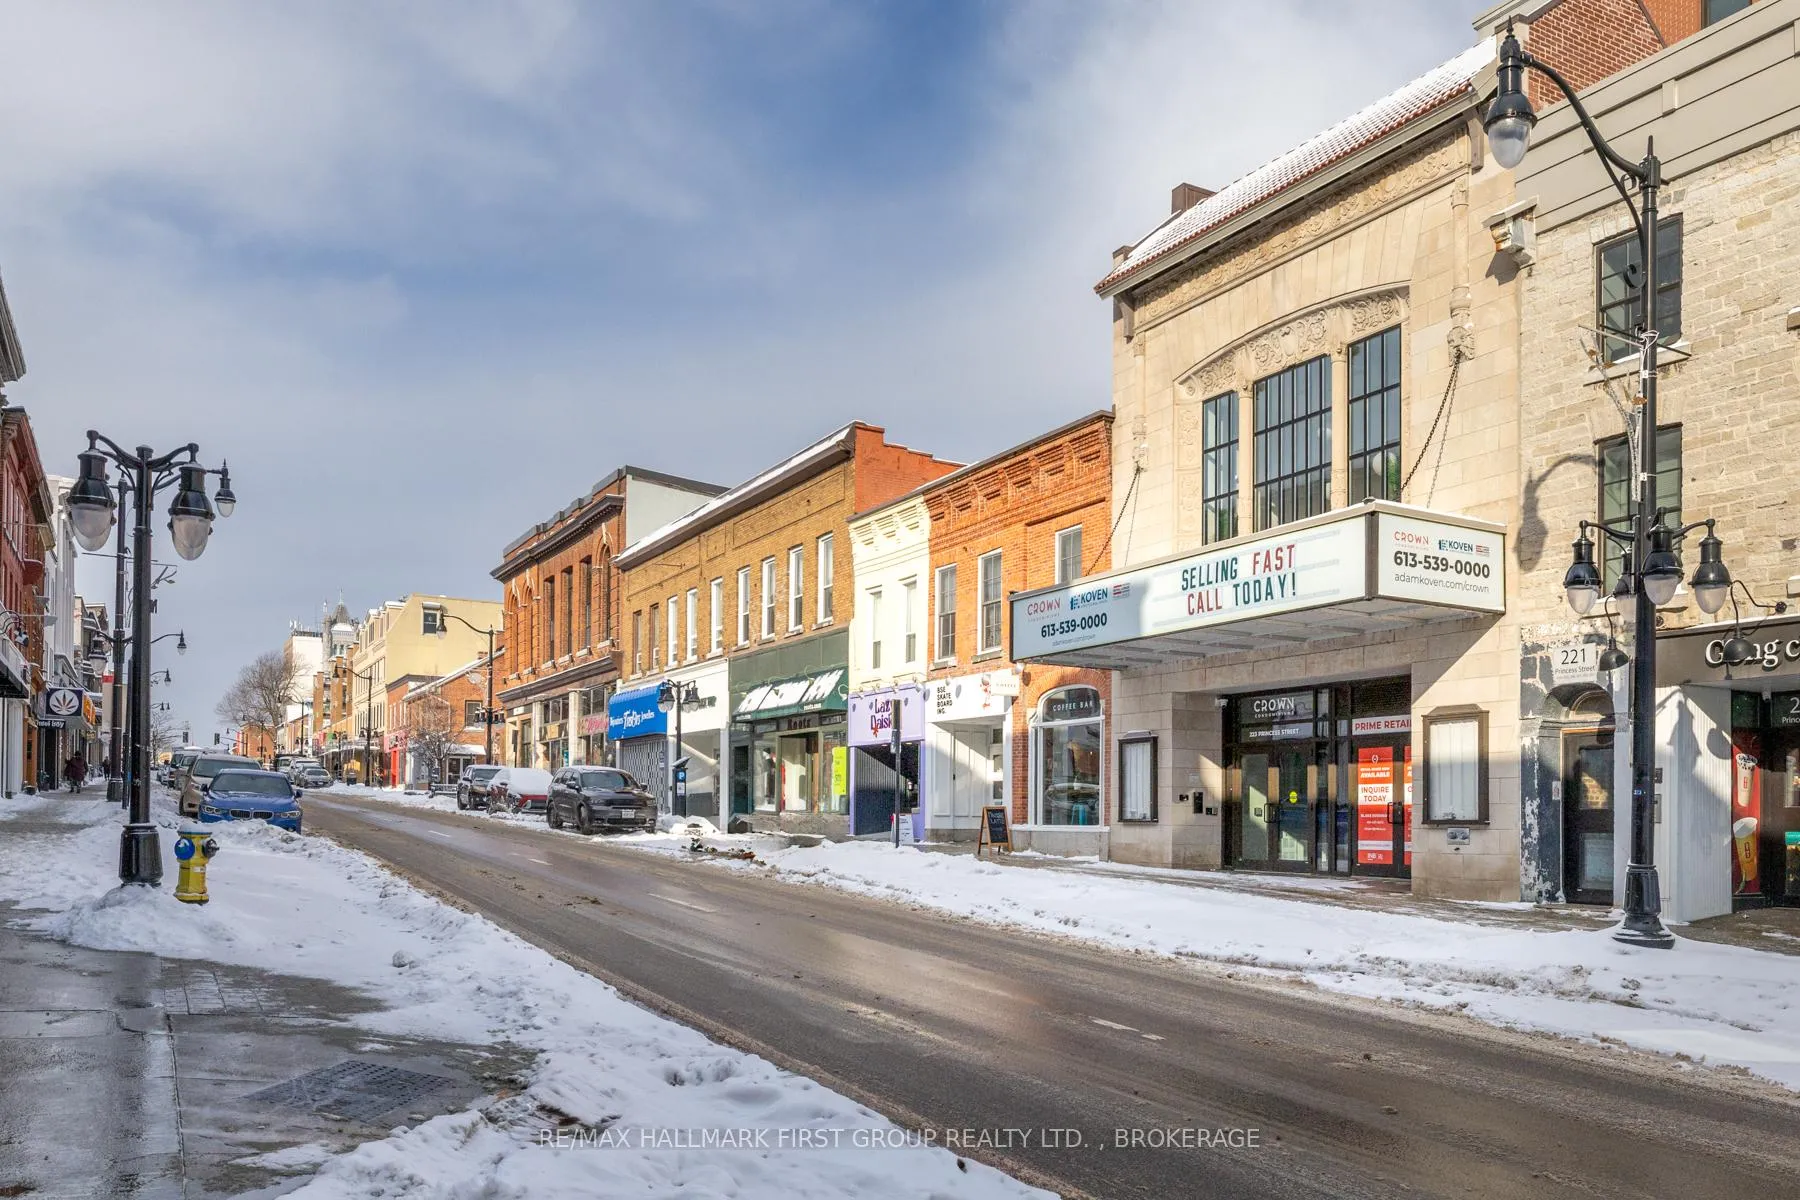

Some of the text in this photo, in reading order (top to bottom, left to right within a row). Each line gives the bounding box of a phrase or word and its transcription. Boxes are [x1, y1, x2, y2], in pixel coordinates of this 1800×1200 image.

[1393, 531, 1429, 545] CROWN
[1448, 540, 1474, 552] KOVEN
[1181, 544, 1295, 591] SELLING FAST
[1393, 550, 1491, 579] 613-539-0000
[1394, 572, 1490, 593] adamkoven.com/crown
[1080, 587, 1109, 604] KOVEN
[1187, 572, 1296, 615] CALL TODAY!
[1027, 597, 1061, 616] CROWN
[1041, 612, 1108, 638] 613-539-0000
[1561, 648, 1586, 665] 221
[1705, 639, 1780, 668] Gng
[1578, 665, 1596, 673] Street
[936, 692, 952, 701] SKATE
[936, 699, 953, 708] BOARD
[1052, 702, 1077, 712] COFFEE
[1254, 697, 1295, 713] CROWN
[787, 718, 812, 731] Roots
[1354, 721, 1382, 731] PRIME
[1281, 728, 1300, 736] STREET
[678, 771, 685, 780] P
[1361, 786, 1390, 794] INQUIRE
